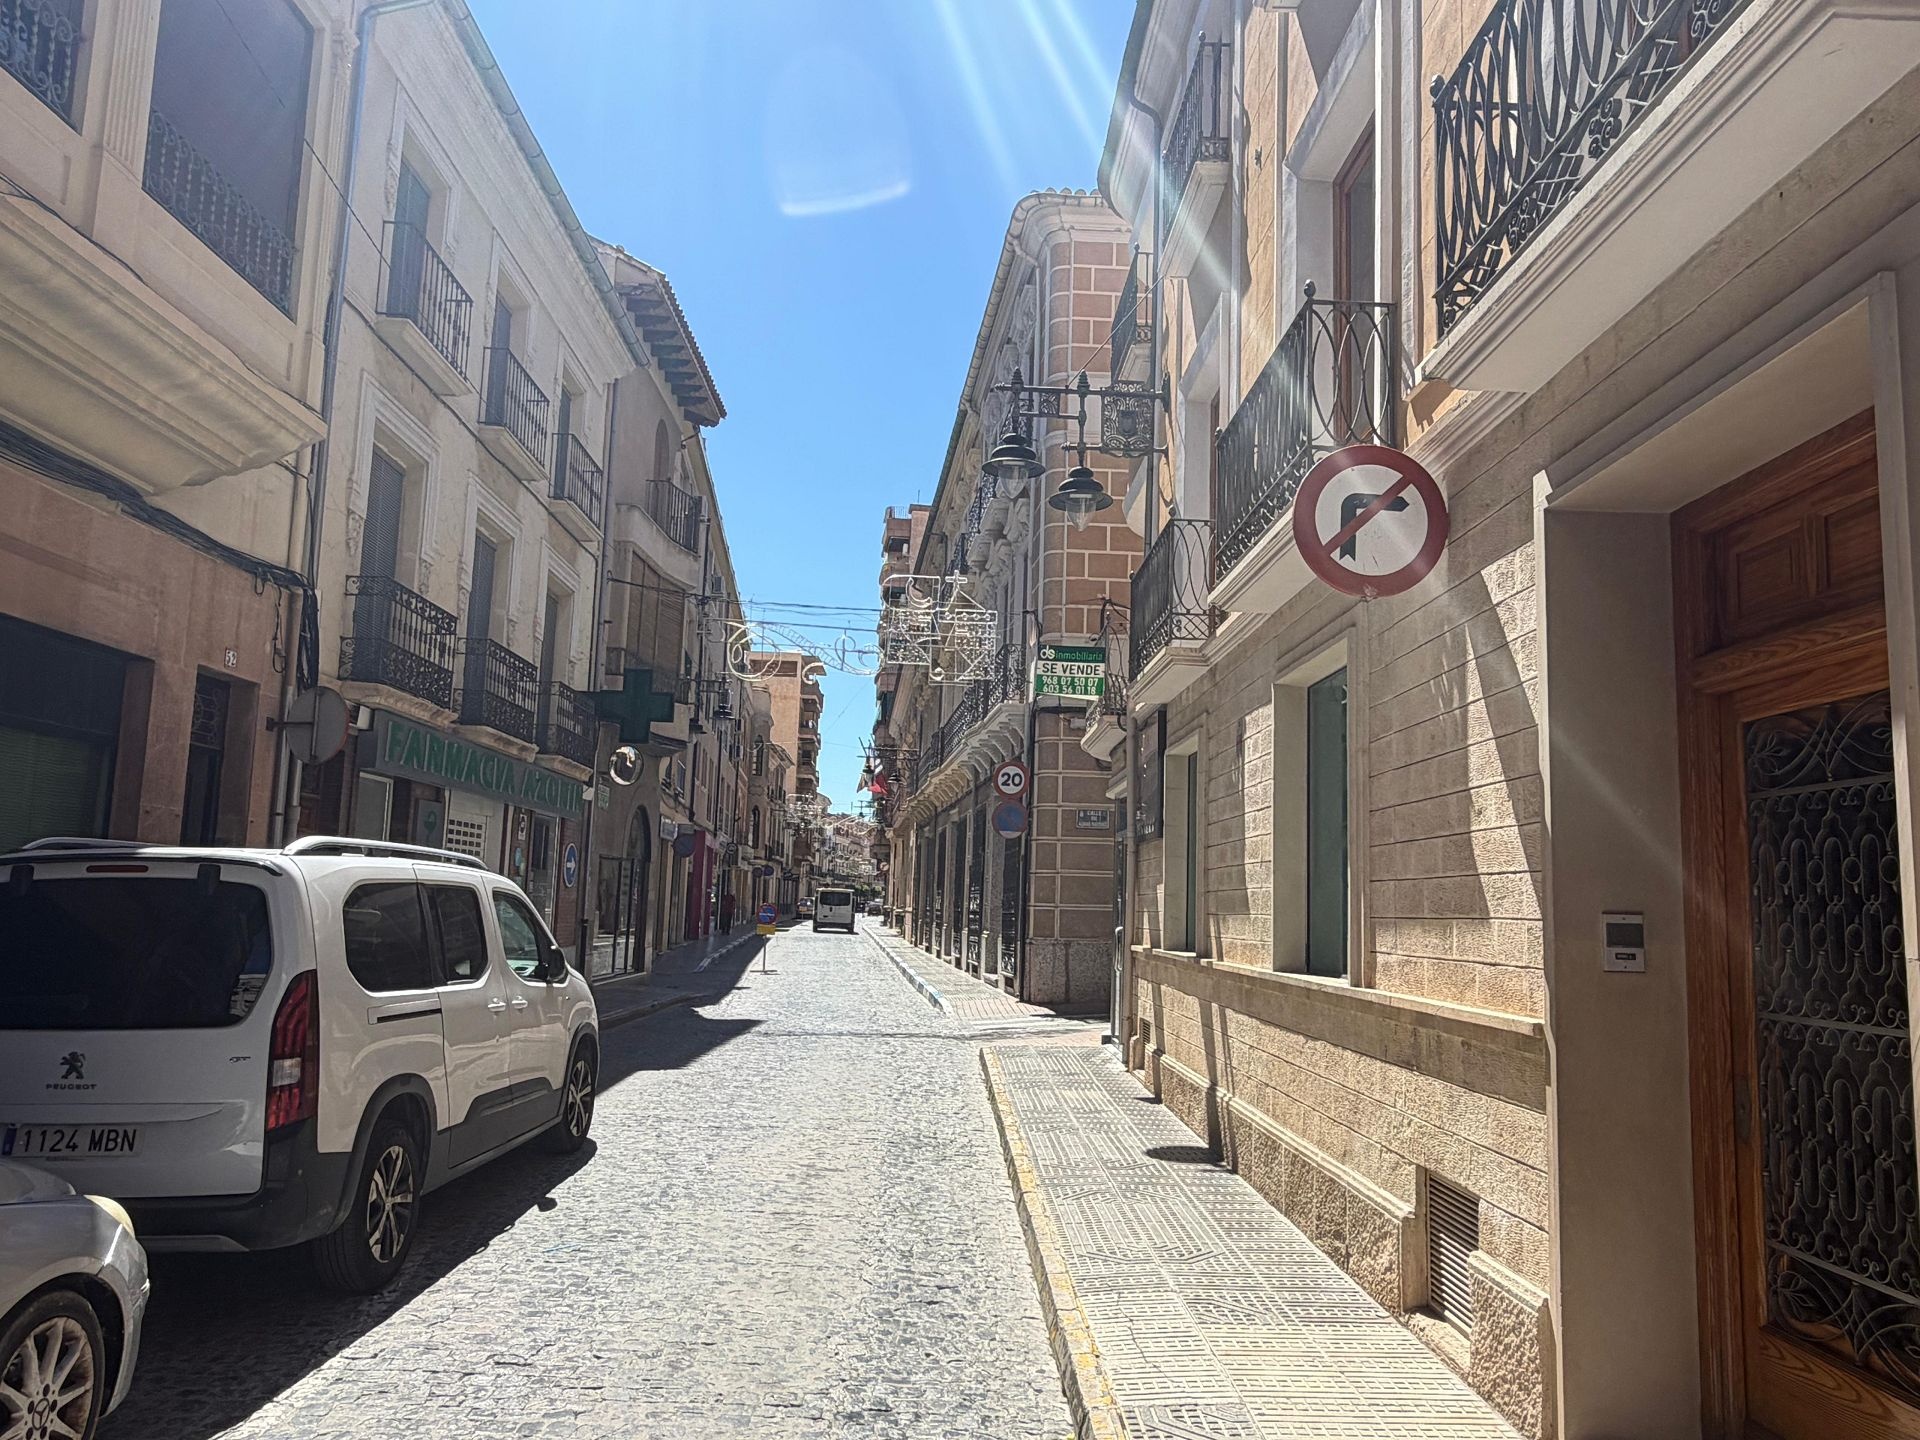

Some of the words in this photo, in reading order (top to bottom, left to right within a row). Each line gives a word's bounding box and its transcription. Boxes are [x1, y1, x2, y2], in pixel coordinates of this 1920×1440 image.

[1042, 662, 1058, 674] SE
[1061, 663, 1101, 676] VENDE
[1042, 676, 1058, 685] 968
[1061, 677, 1072, 686] 07
[1074, 677, 1085, 686] 50
[1087, 678, 1099, 687] 07
[1042, 684, 1059, 694] 603
[1062, 685, 1073, 694] 56
[1075, 686, 1085, 695] 01
[1087, 686, 1097, 695] 18
[384, 721, 515, 796] FARMACIA
[1001, 772, 1023, 787] 20
[23, 1128, 79, 1152] 1124
[87, 1128, 137, 1152] MBN
